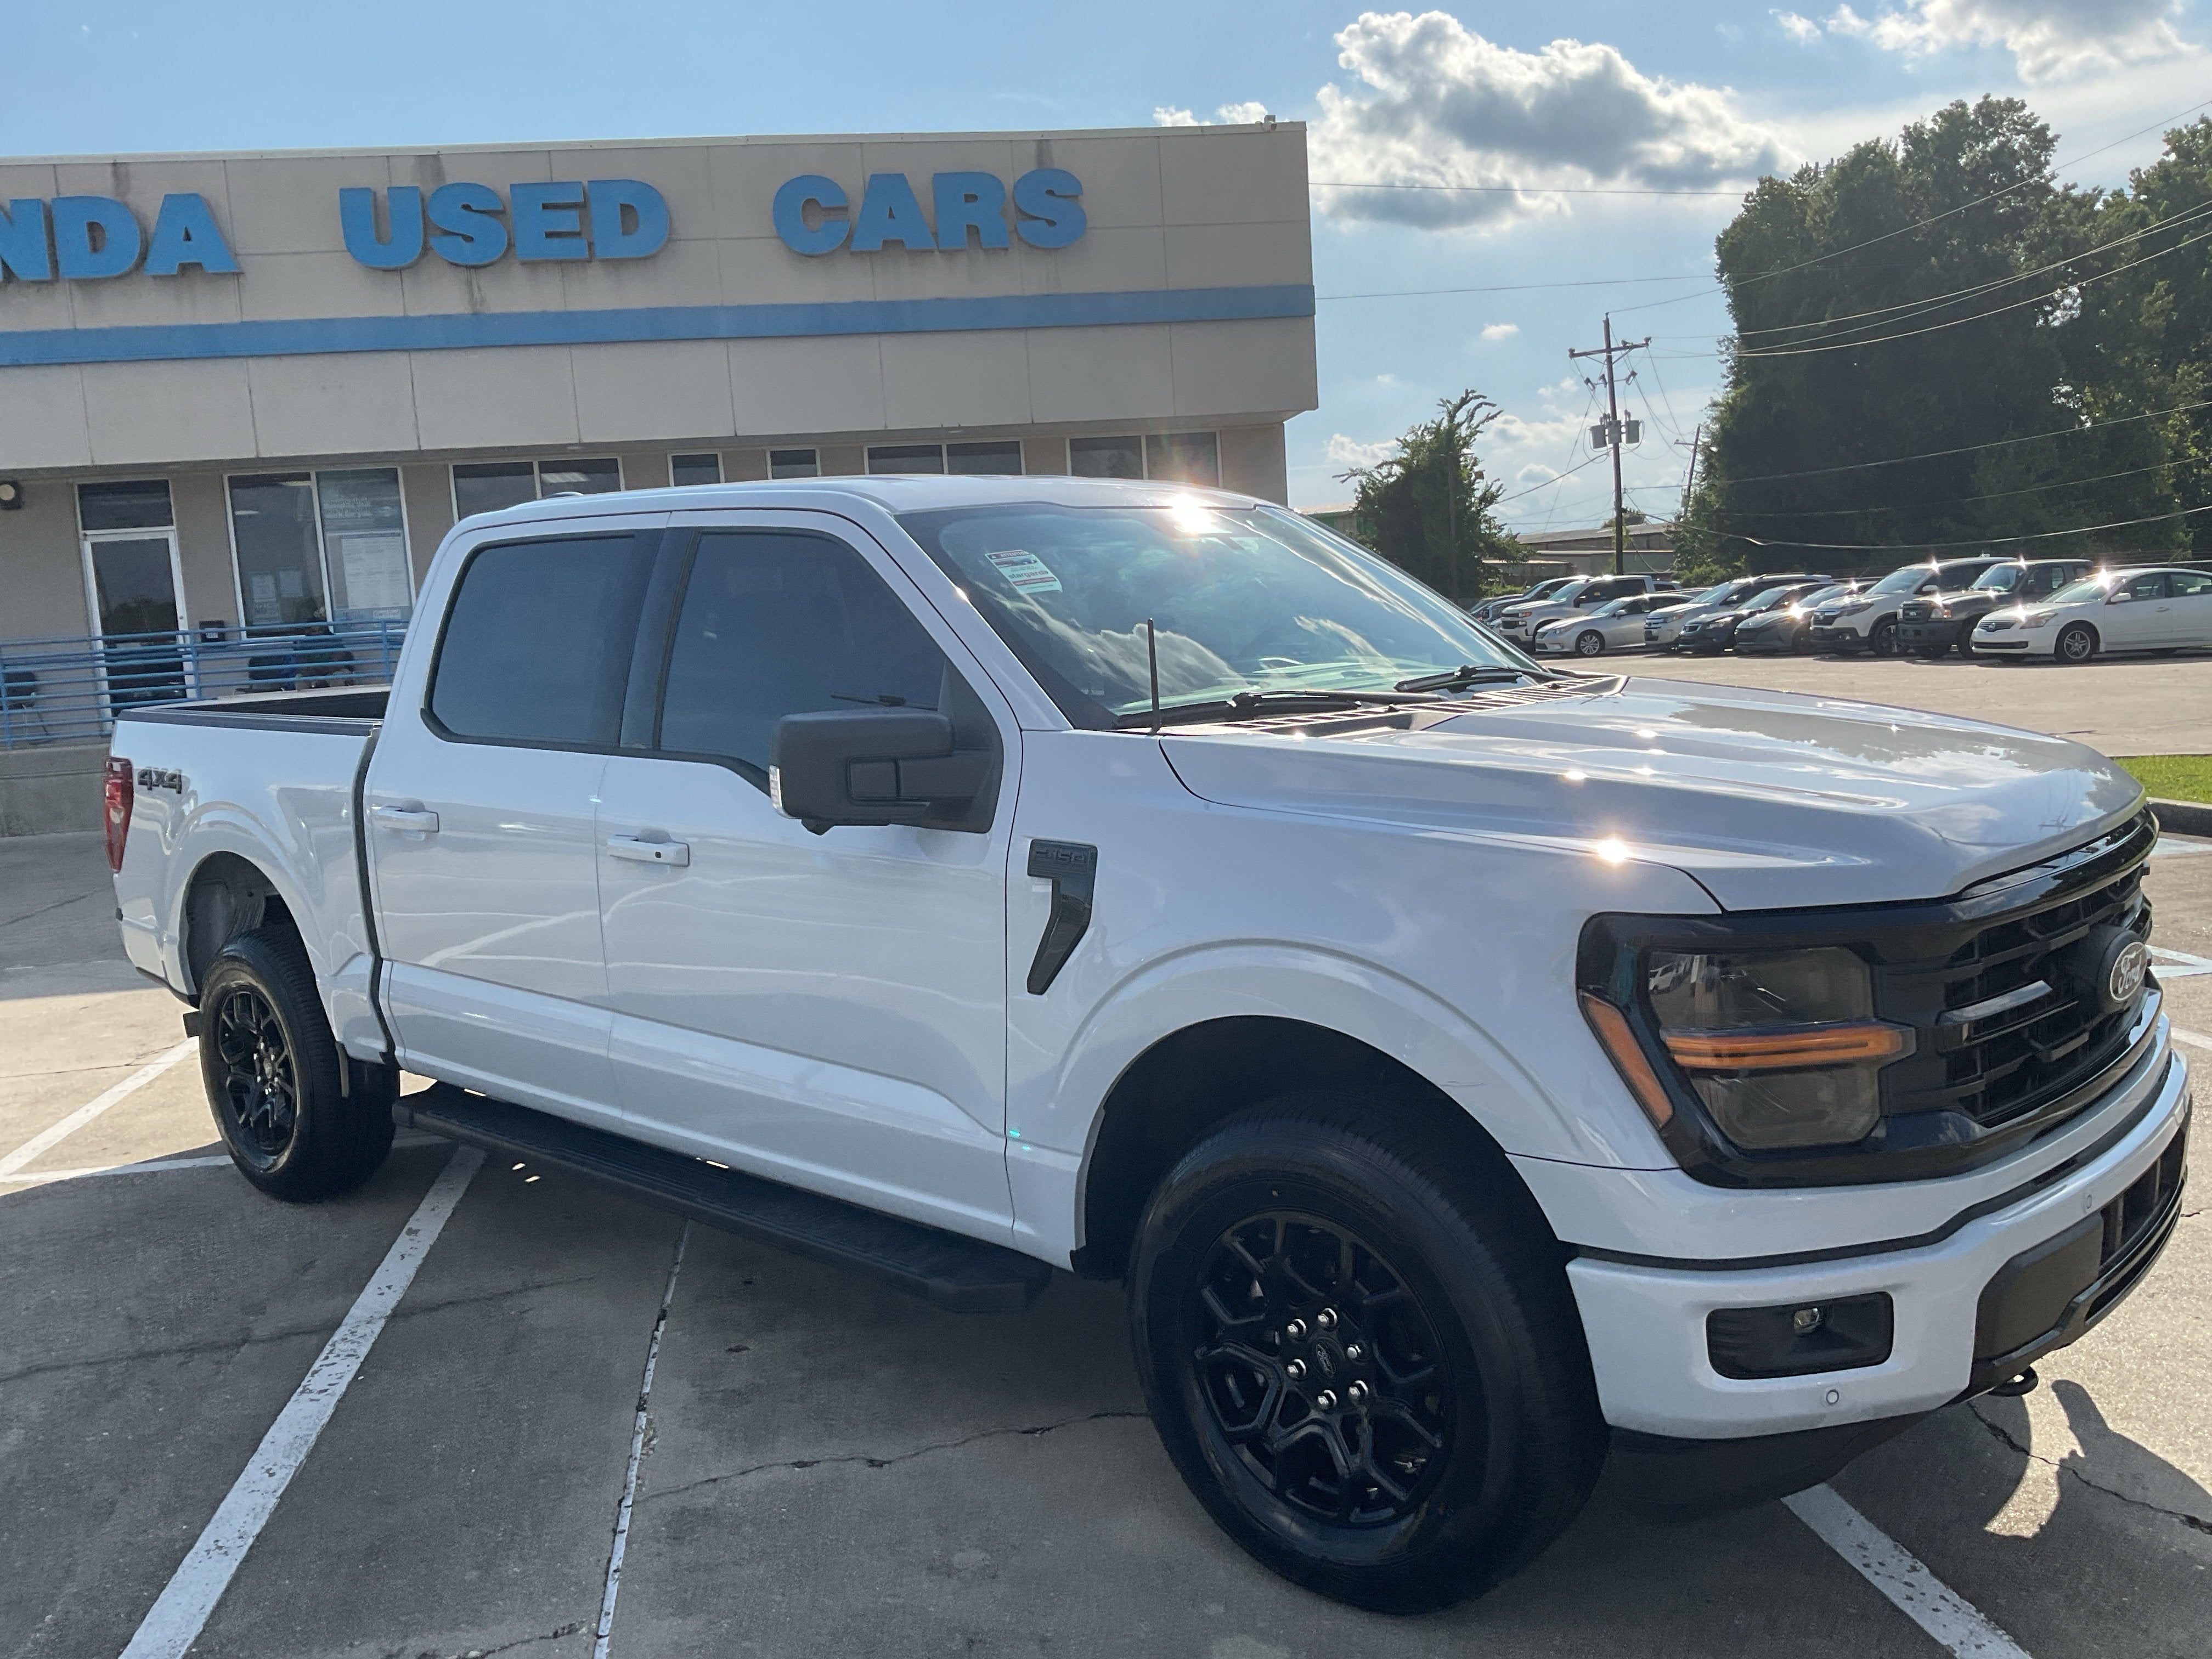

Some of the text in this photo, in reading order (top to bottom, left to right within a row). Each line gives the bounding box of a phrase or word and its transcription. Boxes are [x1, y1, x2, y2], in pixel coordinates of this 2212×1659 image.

[339, 179, 670, 270] USED
[772, 168, 1087, 257] CARS
[2117, 947, 2144, 995] Ford
